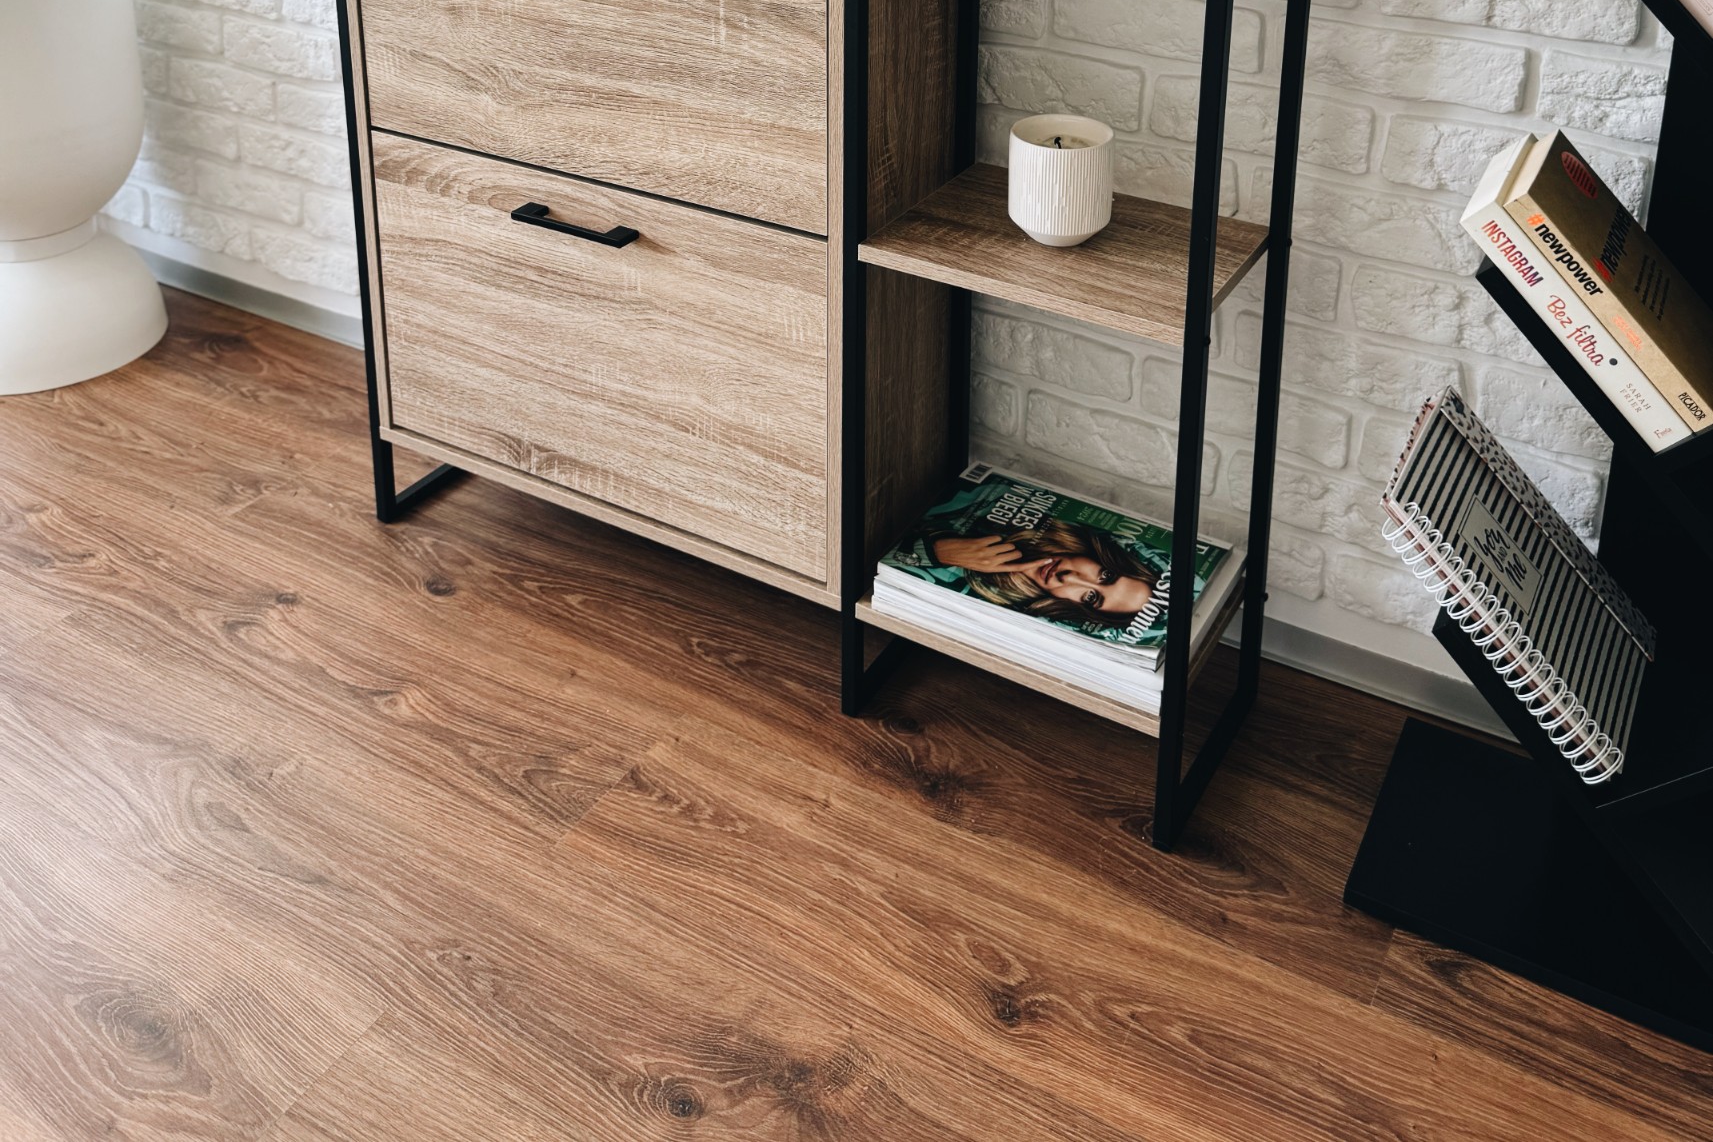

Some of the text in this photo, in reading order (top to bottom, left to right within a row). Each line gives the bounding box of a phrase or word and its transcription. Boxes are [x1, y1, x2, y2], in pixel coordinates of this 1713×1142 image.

[1526, 213, 1604, 297] #newpower
[1481, 220, 1605, 368] INSTAGRAM Bez filtra
[1619, 388, 1643, 414] FRIER
[1625, 383, 1651, 411] SARAH
[1677, 391, 1706, 422] PICADOR
[986, 484, 1035, 526] W BIEGU
[1012, 491, 1057, 530] SUKCES
